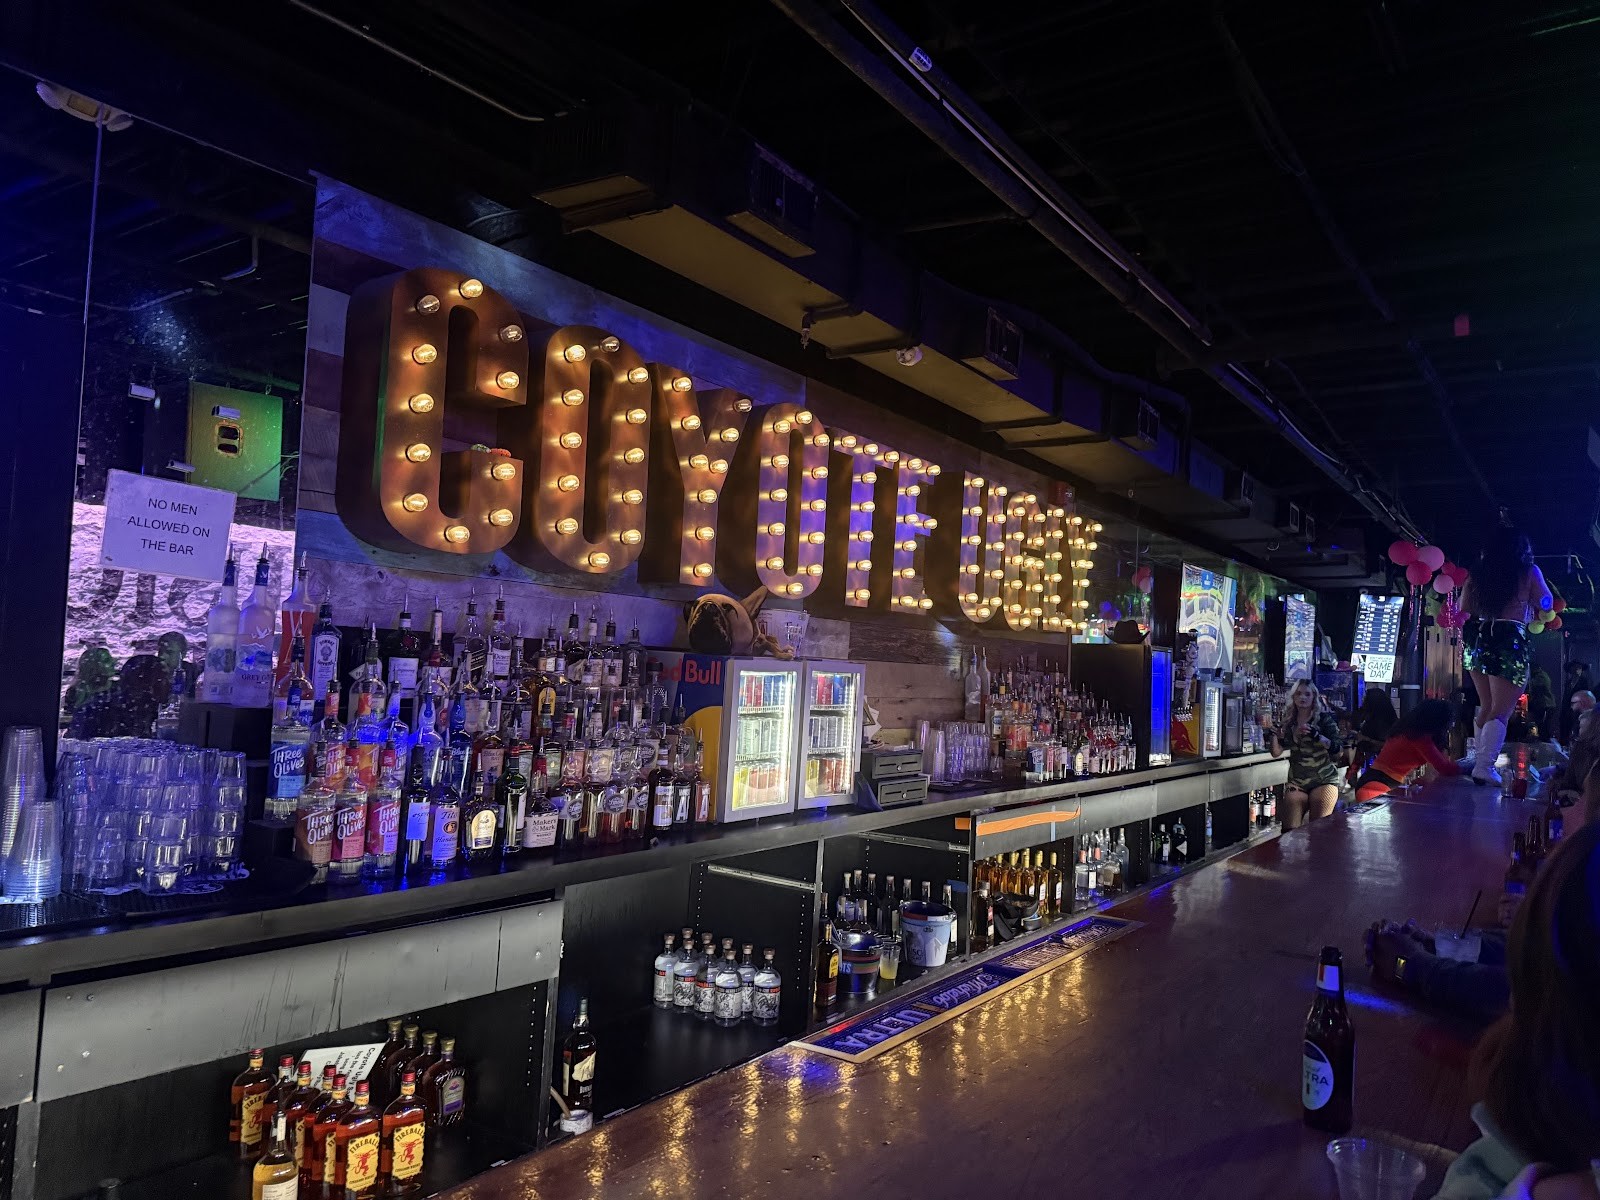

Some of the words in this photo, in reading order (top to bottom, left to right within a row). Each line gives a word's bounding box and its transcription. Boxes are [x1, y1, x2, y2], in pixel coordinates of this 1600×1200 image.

[346, 266, 942, 614] COYOTE
[957, 468, 1104, 633] UGLY
[147, 496, 169, 511] NO
[169, 501, 199, 517] MEN
[126, 514, 190, 535] ALLOWED
[191, 524, 211, 538] ON
[140, 537, 168, 553] THE
[168, 541, 195, 556] BAR
[684, 659, 722, 686] Bull
[1367, 662, 1393, 671] GAME
[1369, 670, 1388, 679] DAY
[833, 1008, 932, 1050] ULTRA
[395, 1127, 425, 1143] FIREBALL
[349, 1138, 380, 1155] FIREBALL
